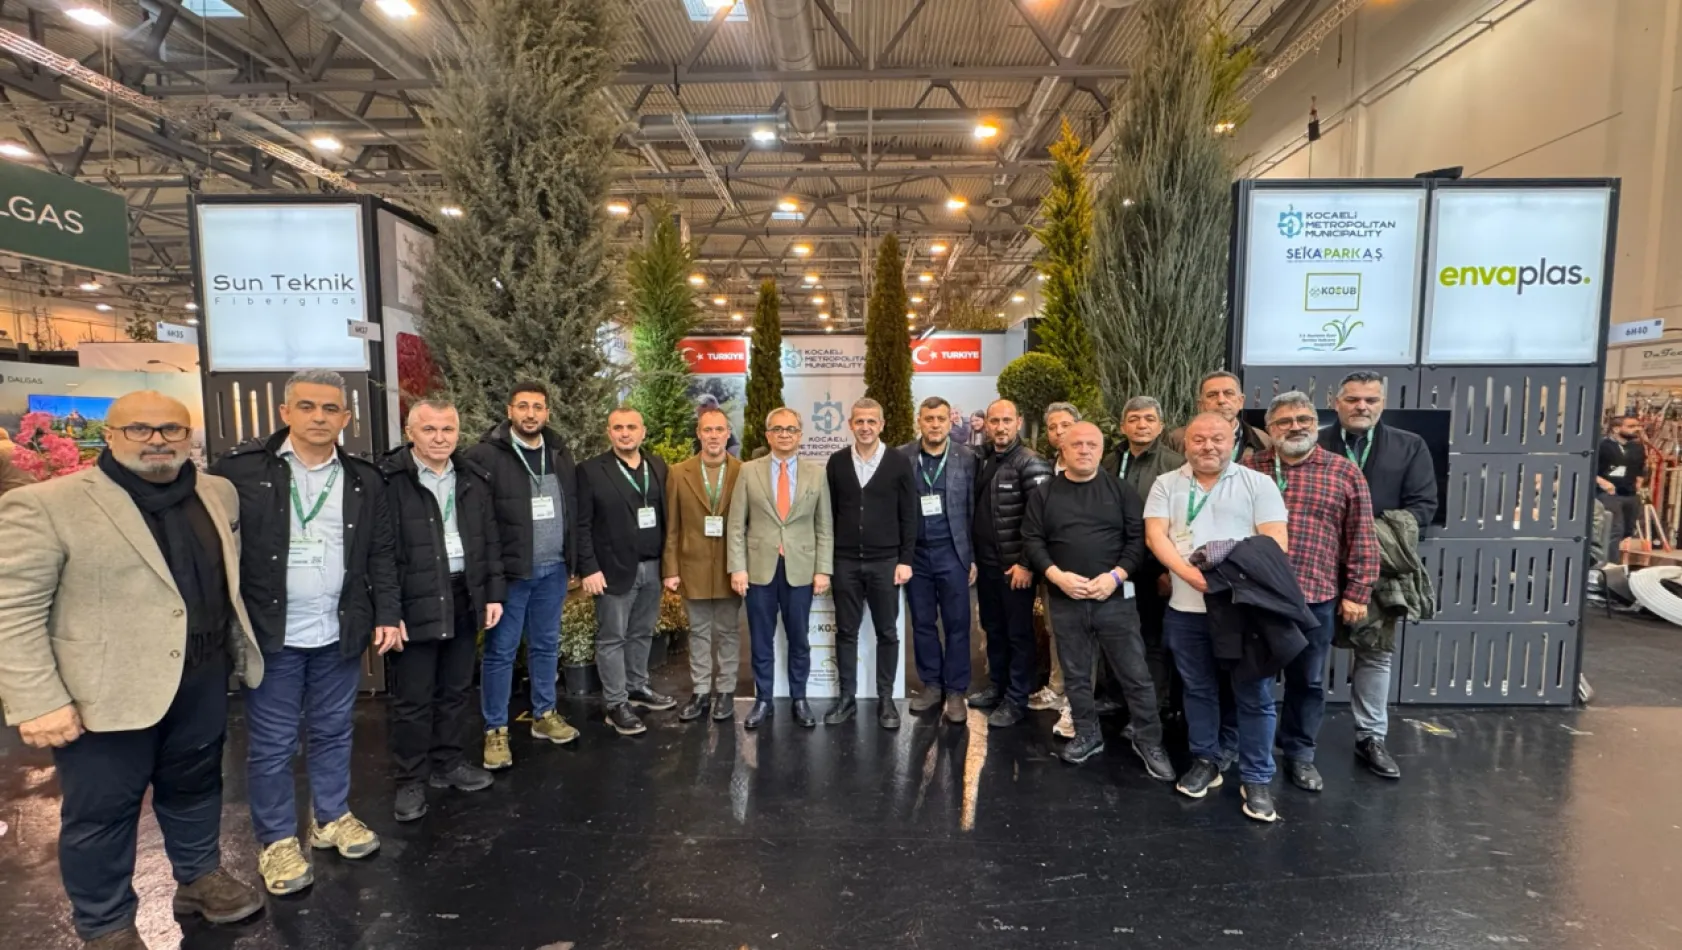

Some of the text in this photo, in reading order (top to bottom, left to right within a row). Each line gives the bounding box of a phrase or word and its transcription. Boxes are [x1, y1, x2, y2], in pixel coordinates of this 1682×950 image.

[1304, 221, 1397, 229] METROPOLITAN
[1304, 230, 1382, 238] MUNICIPALITY
[213, 273, 355, 291] Sun Teknik
[1321, 286, 1357, 295] KOSUB
[7, 375, 43, 385] DALGAS
